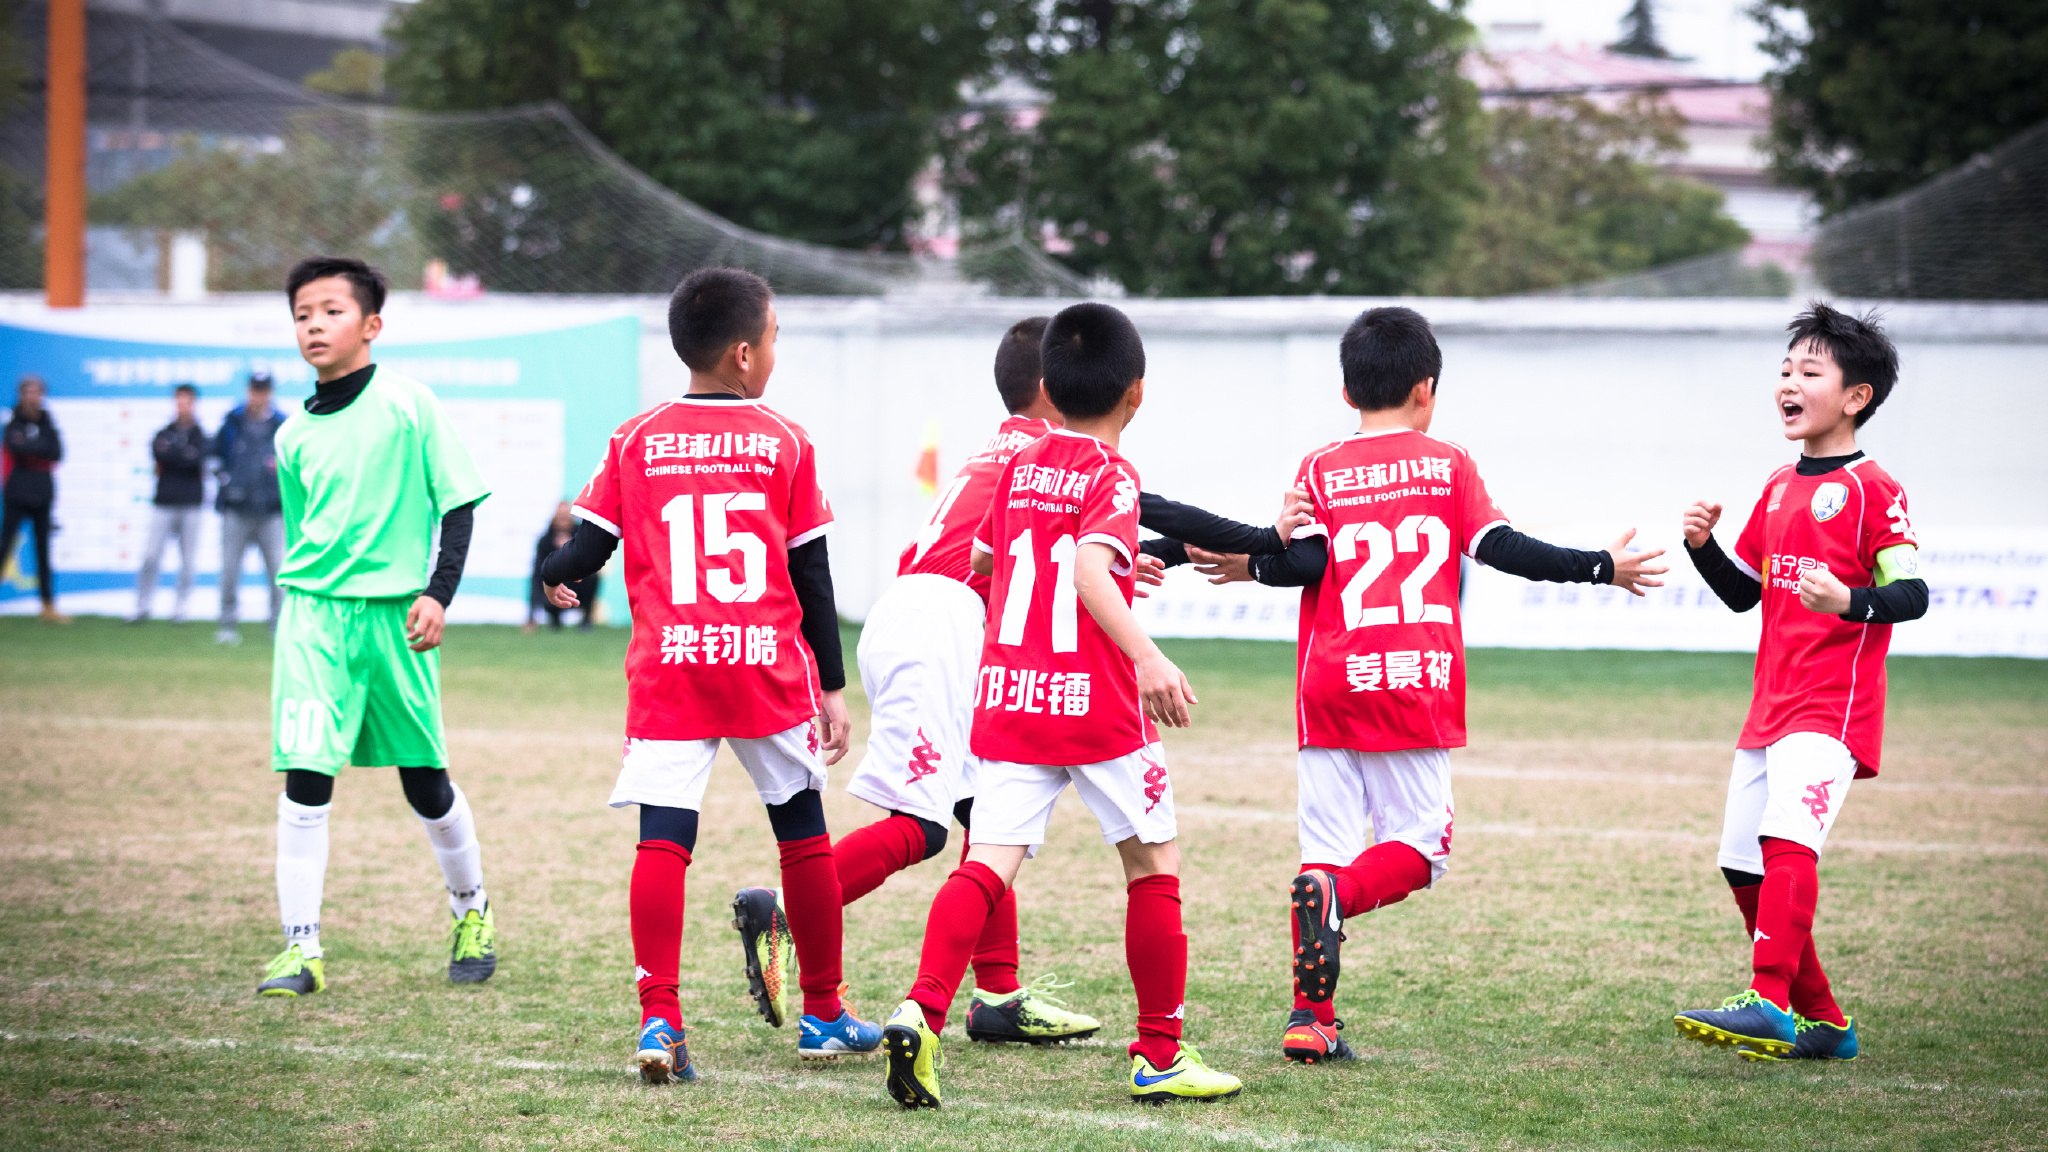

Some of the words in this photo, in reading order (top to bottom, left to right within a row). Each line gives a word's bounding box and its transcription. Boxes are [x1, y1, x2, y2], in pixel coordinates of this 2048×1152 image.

[644, 432, 780, 466] 足球小将
[645, 464, 692, 477] CHINESE
[695, 463, 751, 474] FOOTBALL
[755, 463, 775, 476] BOY
[1009, 463, 1091, 502] 足球小将
[1323, 456, 1452, 498] 足球小将
[1065, 503, 1081, 514] BO
[1327, 495, 1373, 510] CHINESE
[1375, 486, 1429, 502] FOOTBALL
[1431, 486, 1452, 496] BOY
[661, 492, 768, 605] 15
[1771, 553, 1829, 578] 苏宁易
[998, 528, 1078, 653] 11
[1333, 515, 1453, 632] 22
[660, 624, 778, 665] 梁钧皓
[279, 698, 325, 755] 60
